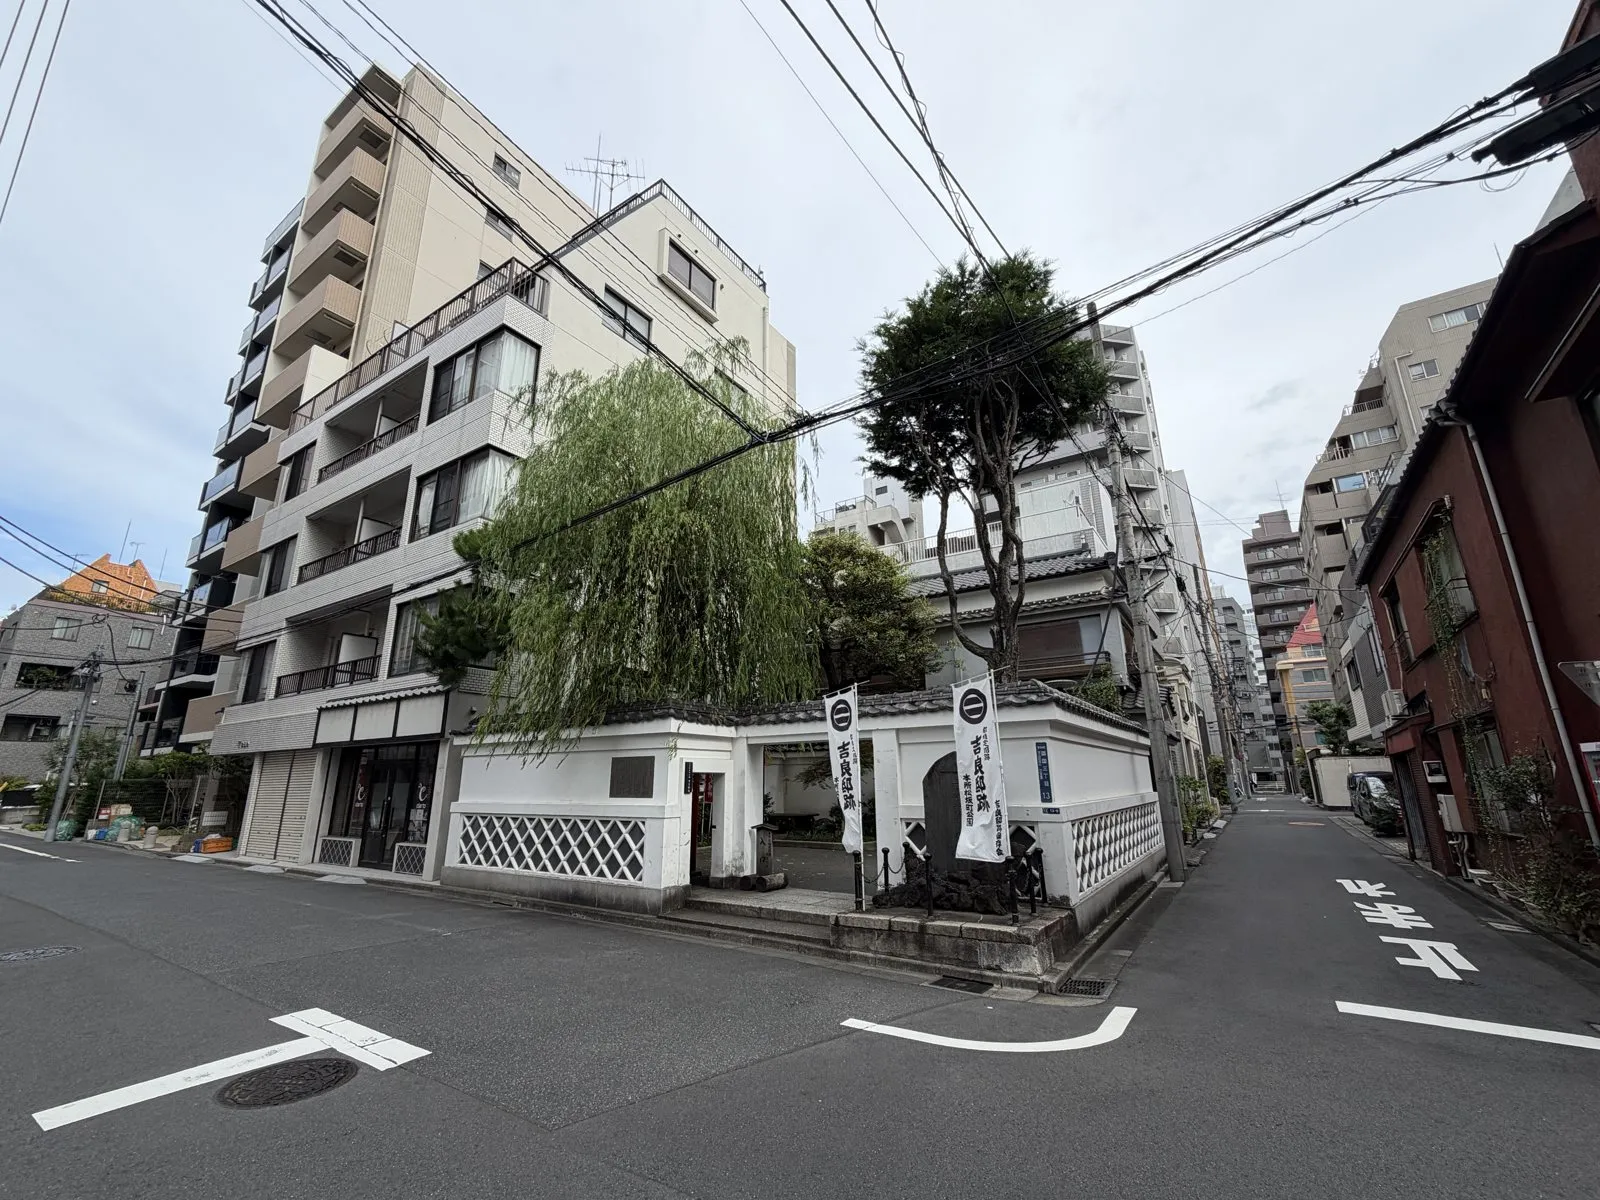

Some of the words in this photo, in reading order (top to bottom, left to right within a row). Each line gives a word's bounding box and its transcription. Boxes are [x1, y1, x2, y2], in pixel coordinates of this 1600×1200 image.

[1042, 792, 1051, 800] 13
[1335, 878, 1481, 981] 止まれ
